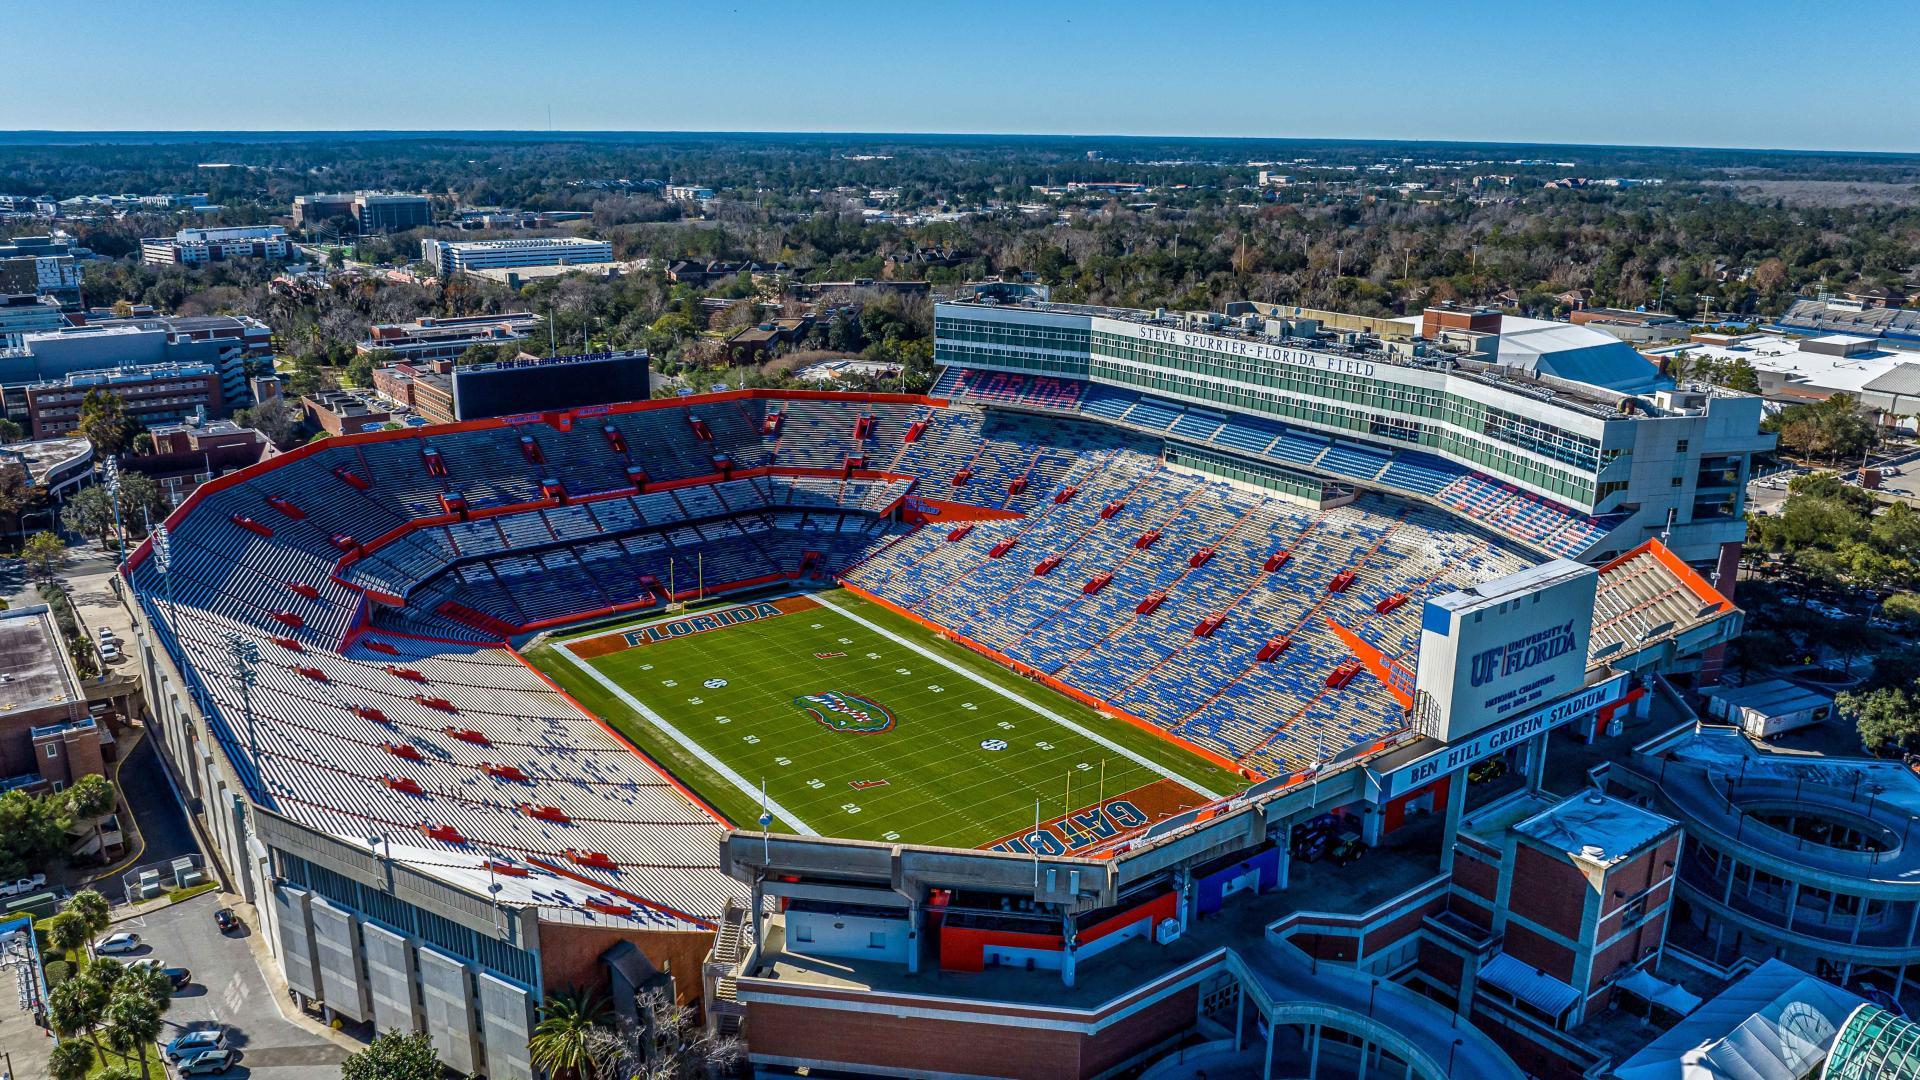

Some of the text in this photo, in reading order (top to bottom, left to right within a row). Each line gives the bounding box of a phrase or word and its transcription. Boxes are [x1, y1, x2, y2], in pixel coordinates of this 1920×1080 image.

[1141, 327, 1175, 342] STEVE
[1328, 358, 1374, 376] FIELD
[496, 352, 612, 370] BEN HILL GRIFFIN STADIUM
[622, 602, 784, 648] FLORIDA
[1508, 618, 1575, 653] UNIVERSITY of
[1470, 631, 1577, 688] UF FLORIDA
[1484, 674, 1556, 709] NATIONAL CHAMPIONS
[961, 702, 978, 711] 40
[997, 721, 1015, 730] 30
[743, 734, 760, 744] 50
[1410, 687, 1608, 784] BEN HILL GRIFFIN STADIUM
[1036, 741, 1055, 751] 20
[775, 756, 792, 766] 40
[1076, 762, 1094, 772] 10
[806, 778, 826, 790] 30
[841, 802, 862, 815] 20
[882, 830, 901, 841] 10
